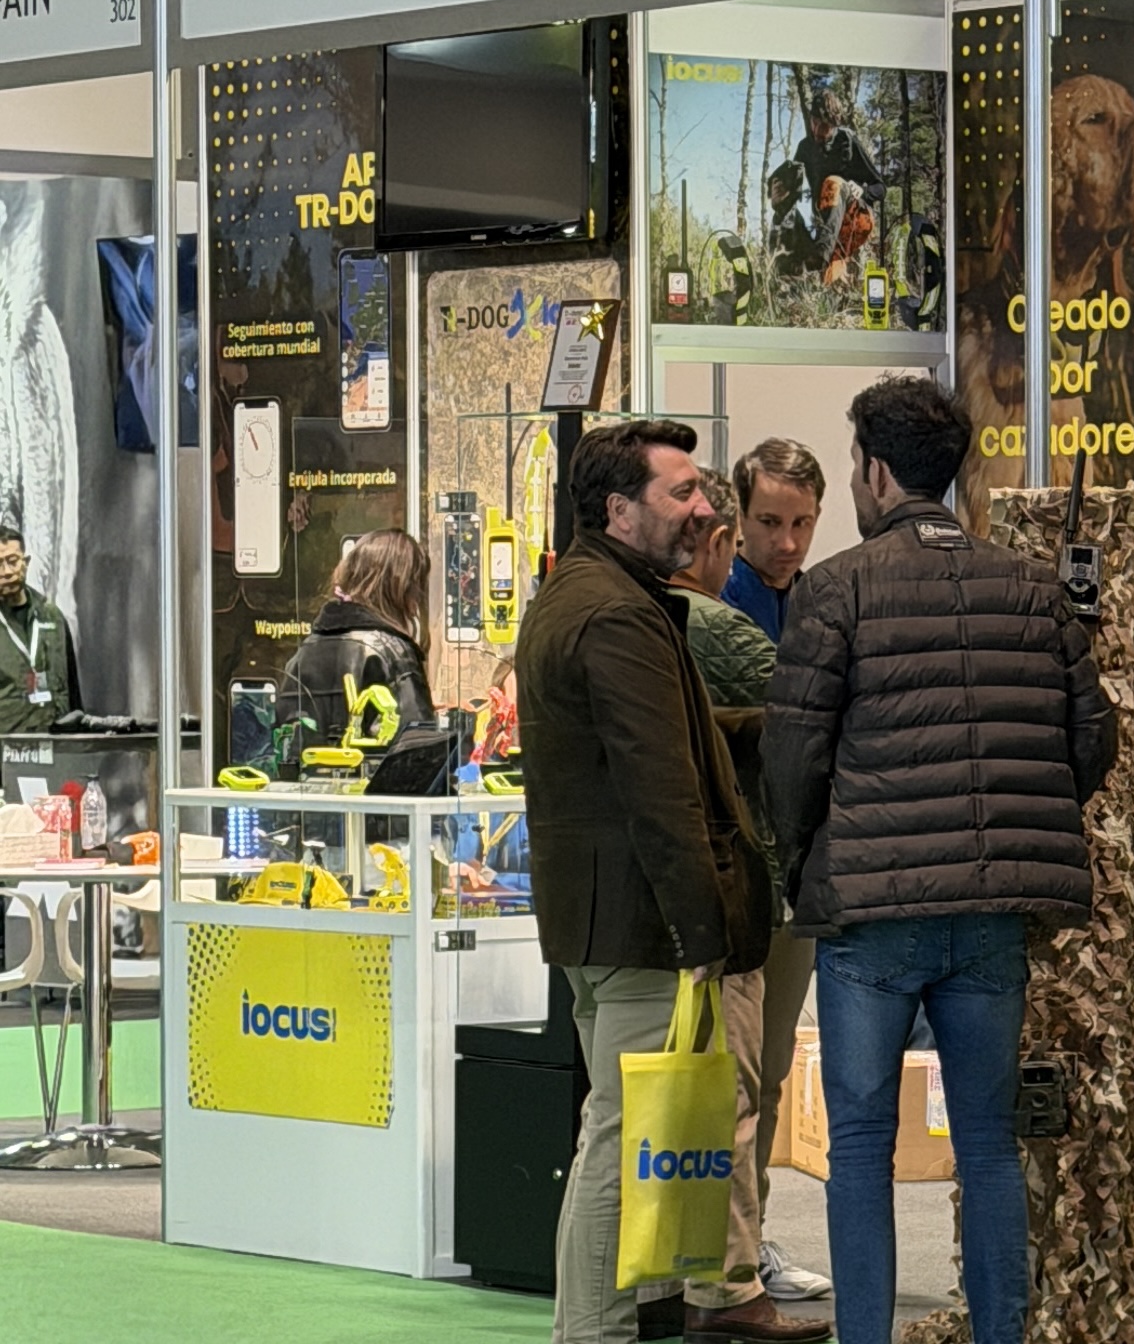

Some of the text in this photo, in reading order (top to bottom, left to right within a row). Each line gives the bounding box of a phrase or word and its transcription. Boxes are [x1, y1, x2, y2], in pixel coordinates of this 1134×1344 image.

[295, 188, 376, 229] TR-DO
[1007, 290, 1131, 334] Ceado
[227, 320, 315, 341] Seguimiento con
[222, 337, 321, 358] cobertura mundial
[330, 467, 397, 489] incorporada
[255, 618, 312, 638] Waypoints
